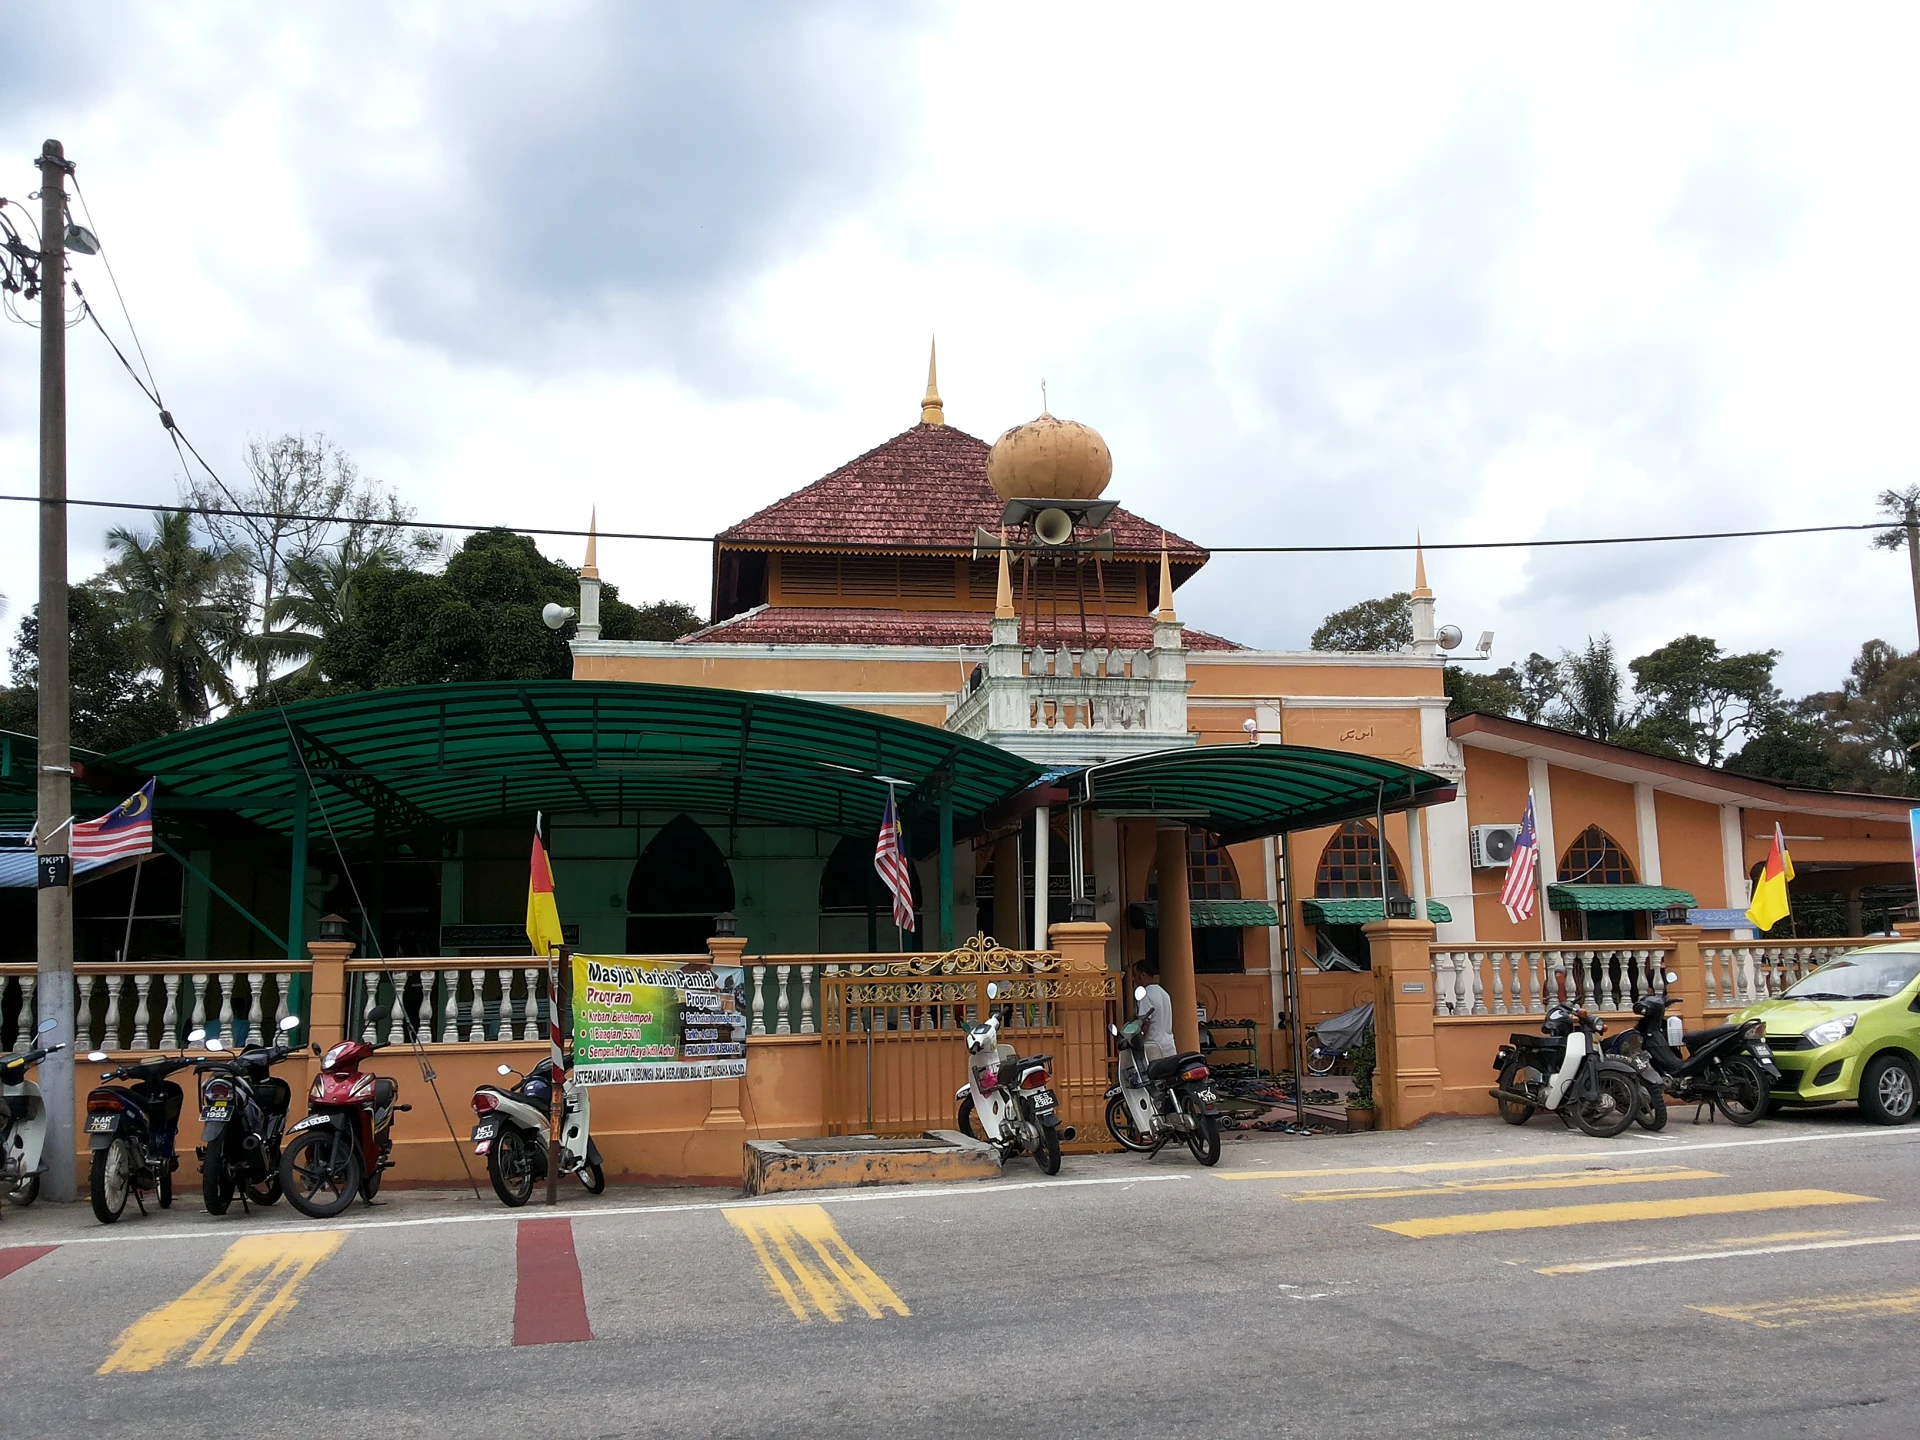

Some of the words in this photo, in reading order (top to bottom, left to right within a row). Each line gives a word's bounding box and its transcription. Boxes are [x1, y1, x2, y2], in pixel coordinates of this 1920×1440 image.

[40, 856, 65, 865] PKPT
[48, 866, 56, 875] C
[49, 875, 56, 883] 7
[588, 962, 635, 988] Masjid
[635, 967, 677, 987] Kariah
[677, 970, 715, 989] Pantai
[587, 987, 632, 1006] Program
[686, 992, 718, 1009] Program
[615, 1045, 629, 1056] Hari
